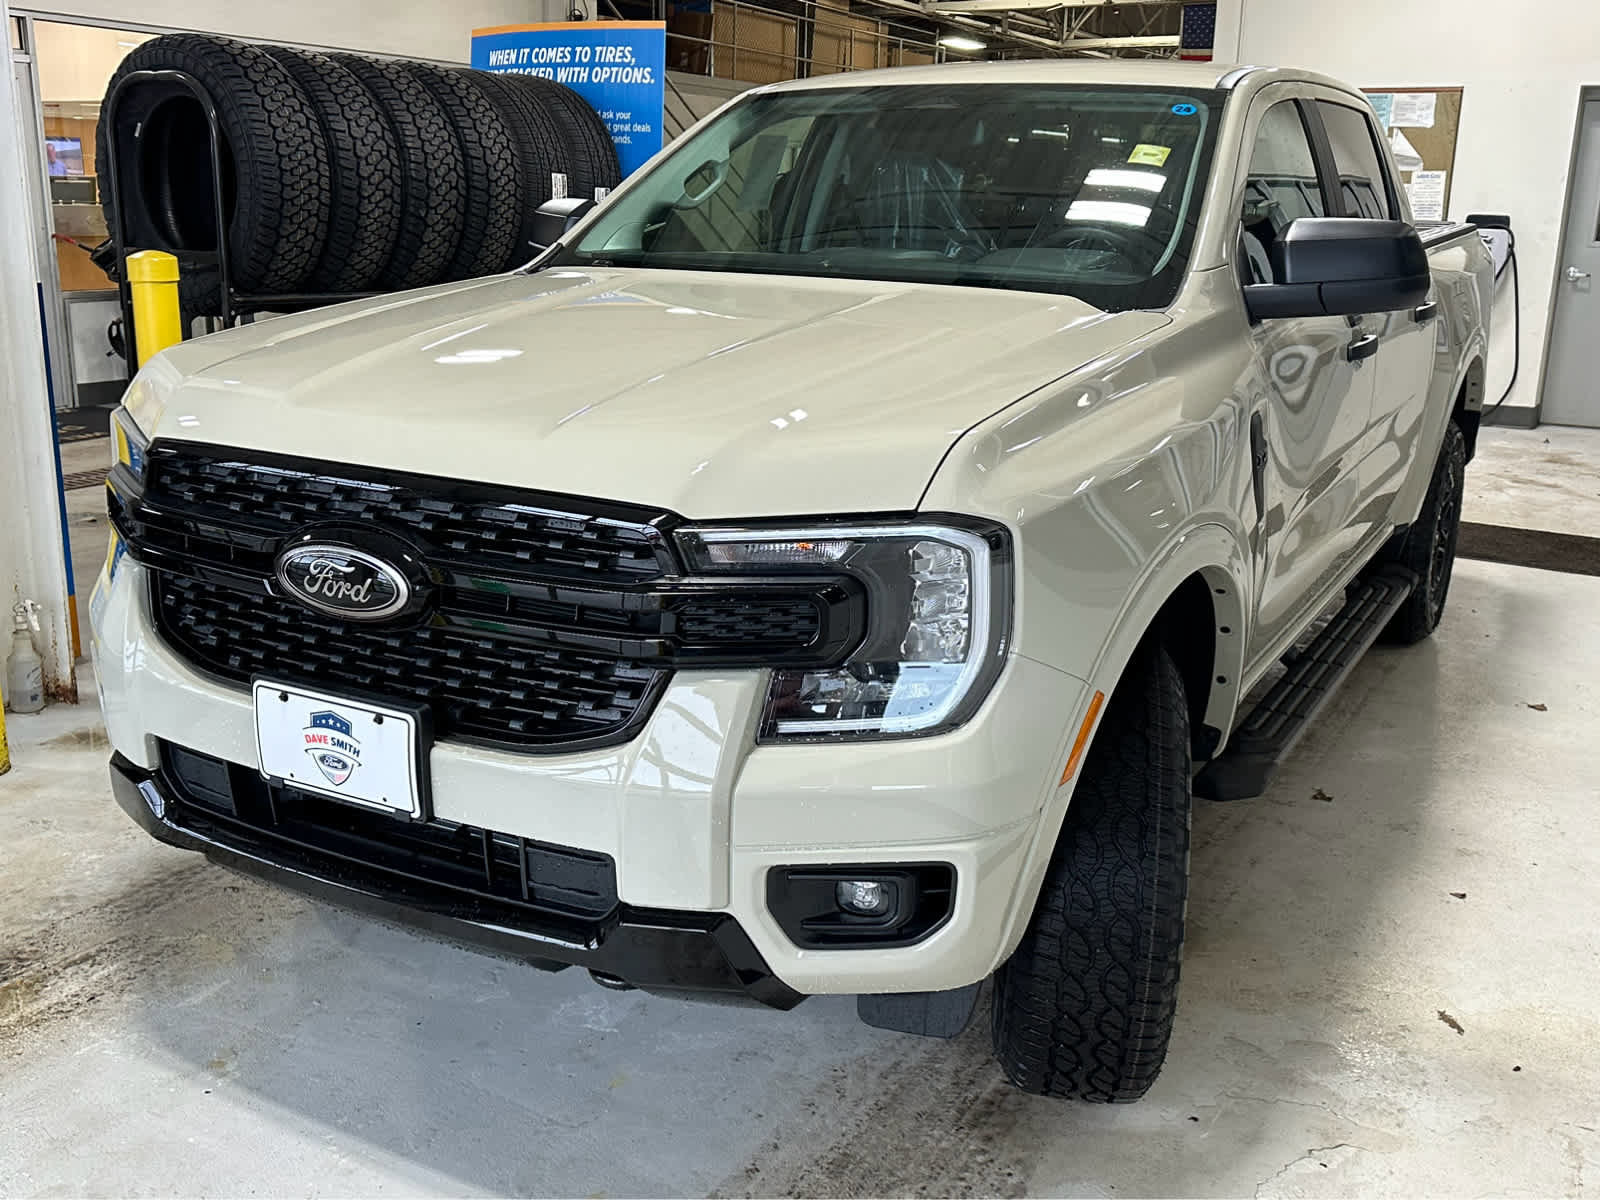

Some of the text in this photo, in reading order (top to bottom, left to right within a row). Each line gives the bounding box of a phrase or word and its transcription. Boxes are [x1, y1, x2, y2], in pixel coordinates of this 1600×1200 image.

[489, 46, 636, 66] WHEN IT COMES TO TIRES,
[556, 66, 588, 83] WITH
[591, 67, 655, 84] OPTIONS.
[601, 109, 614, 119] ask
[615, 111, 632, 121] your
[612, 122, 631, 133] great
[632, 122, 651, 132] deals
[611, 134, 633, 144] rands.
[303, 558, 372, 603] Ford
[304, 734, 360, 758] DAVE SMITH
